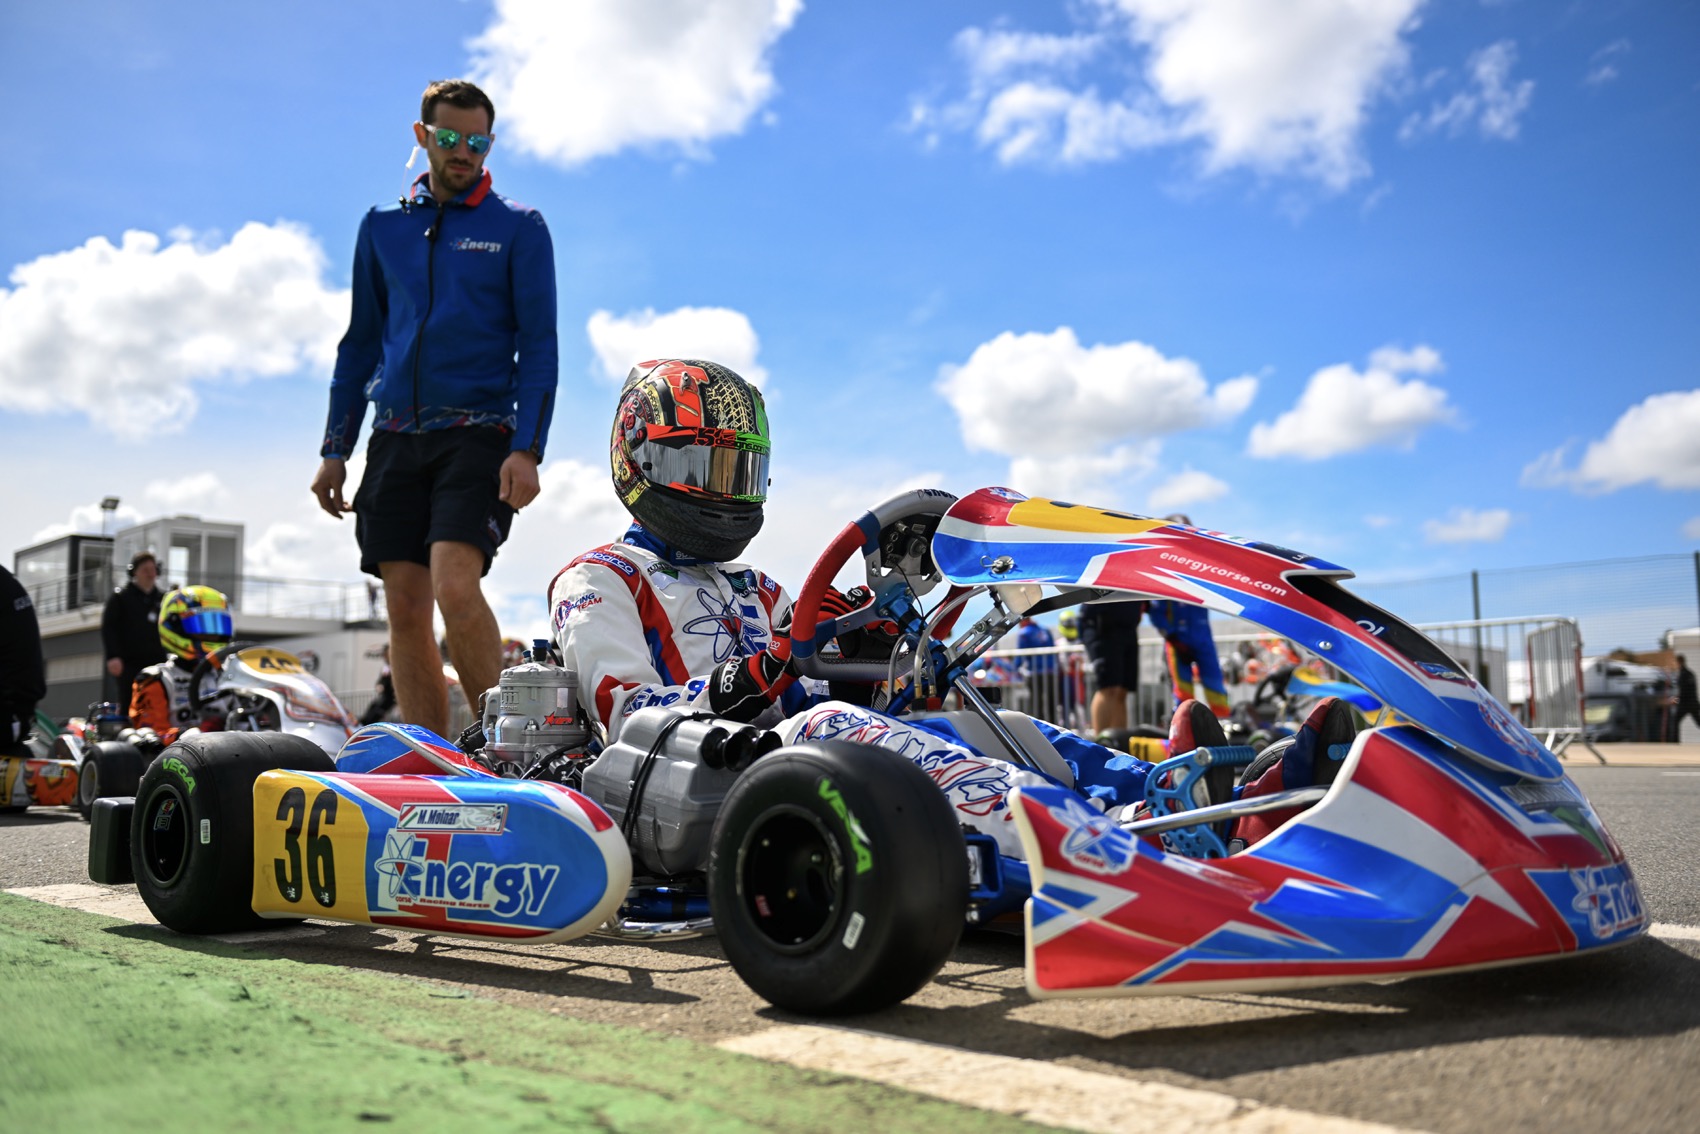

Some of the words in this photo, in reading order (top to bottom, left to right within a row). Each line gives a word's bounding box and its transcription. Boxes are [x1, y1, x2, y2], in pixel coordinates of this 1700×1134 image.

[1159, 551, 1287, 598] energycorse.com
[577, 597, 602, 612] TEAM
[723, 658, 743, 693] parco
[162, 758, 196, 796] VEGA
[274, 786, 338, 908] 36
[398, 840, 558, 914] Energy
[419, 897, 457, 907] Racing
